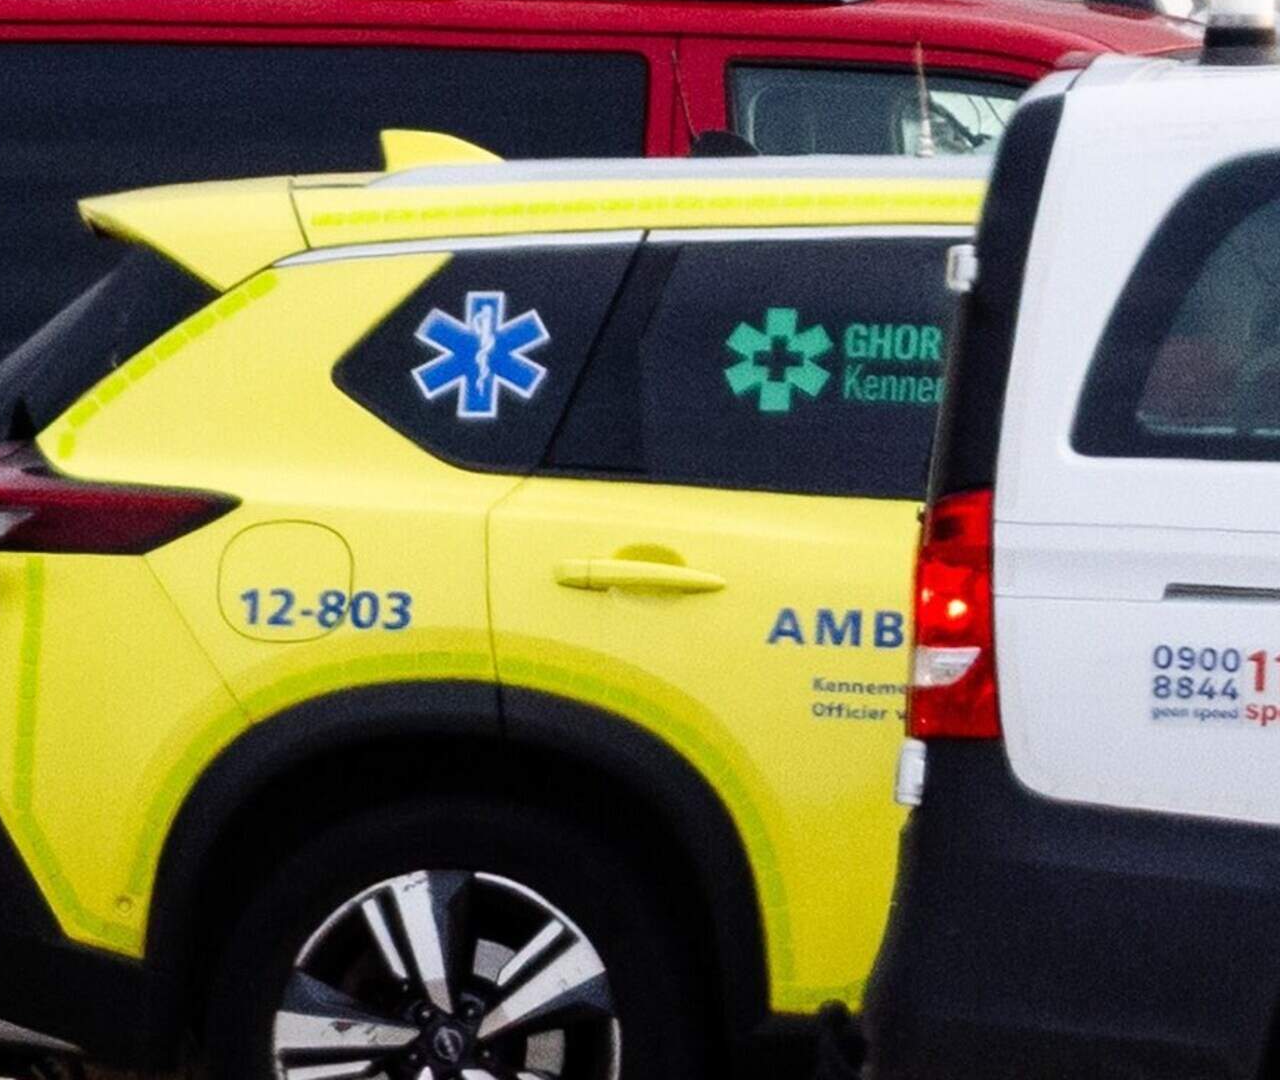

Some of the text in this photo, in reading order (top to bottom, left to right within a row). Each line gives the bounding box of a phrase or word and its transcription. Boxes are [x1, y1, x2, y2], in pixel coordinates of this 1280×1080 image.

[844, 323, 944, 360] GHOR
[240, 588, 412, 631] 12-803
[766, 607, 905, 648] AMB
[1153, 644, 1240, 673] 0900
[1153, 674, 1239, 700] 8844
[811, 702, 887, 720] Officier
